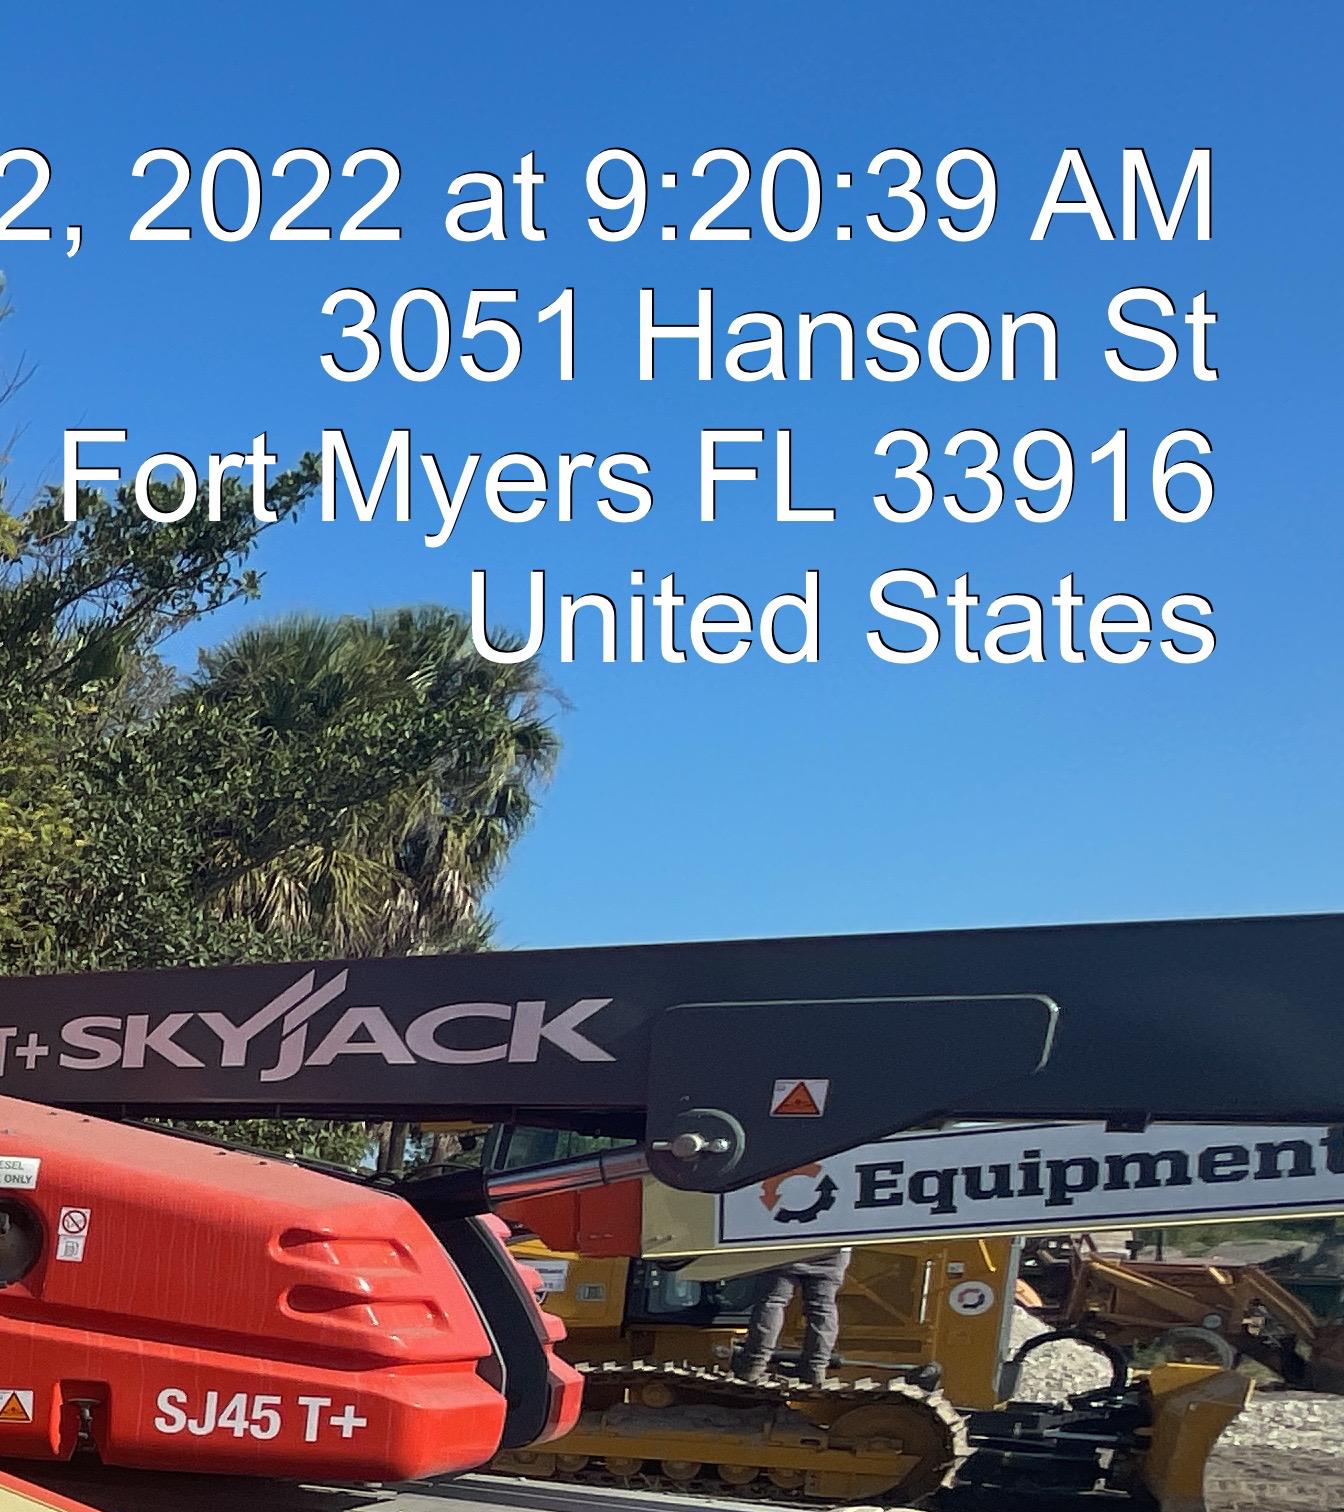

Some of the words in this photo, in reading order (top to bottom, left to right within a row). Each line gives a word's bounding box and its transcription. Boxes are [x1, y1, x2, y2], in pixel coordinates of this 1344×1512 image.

[59, 967, 617, 1083] SKYJACK
[3, 1173, 33, 1185] ONLY
[854, 1126, 1344, 1215] Equipment
[153, 1387, 283, 1441] SJ45
[297, 1394, 369, 1443] T+
